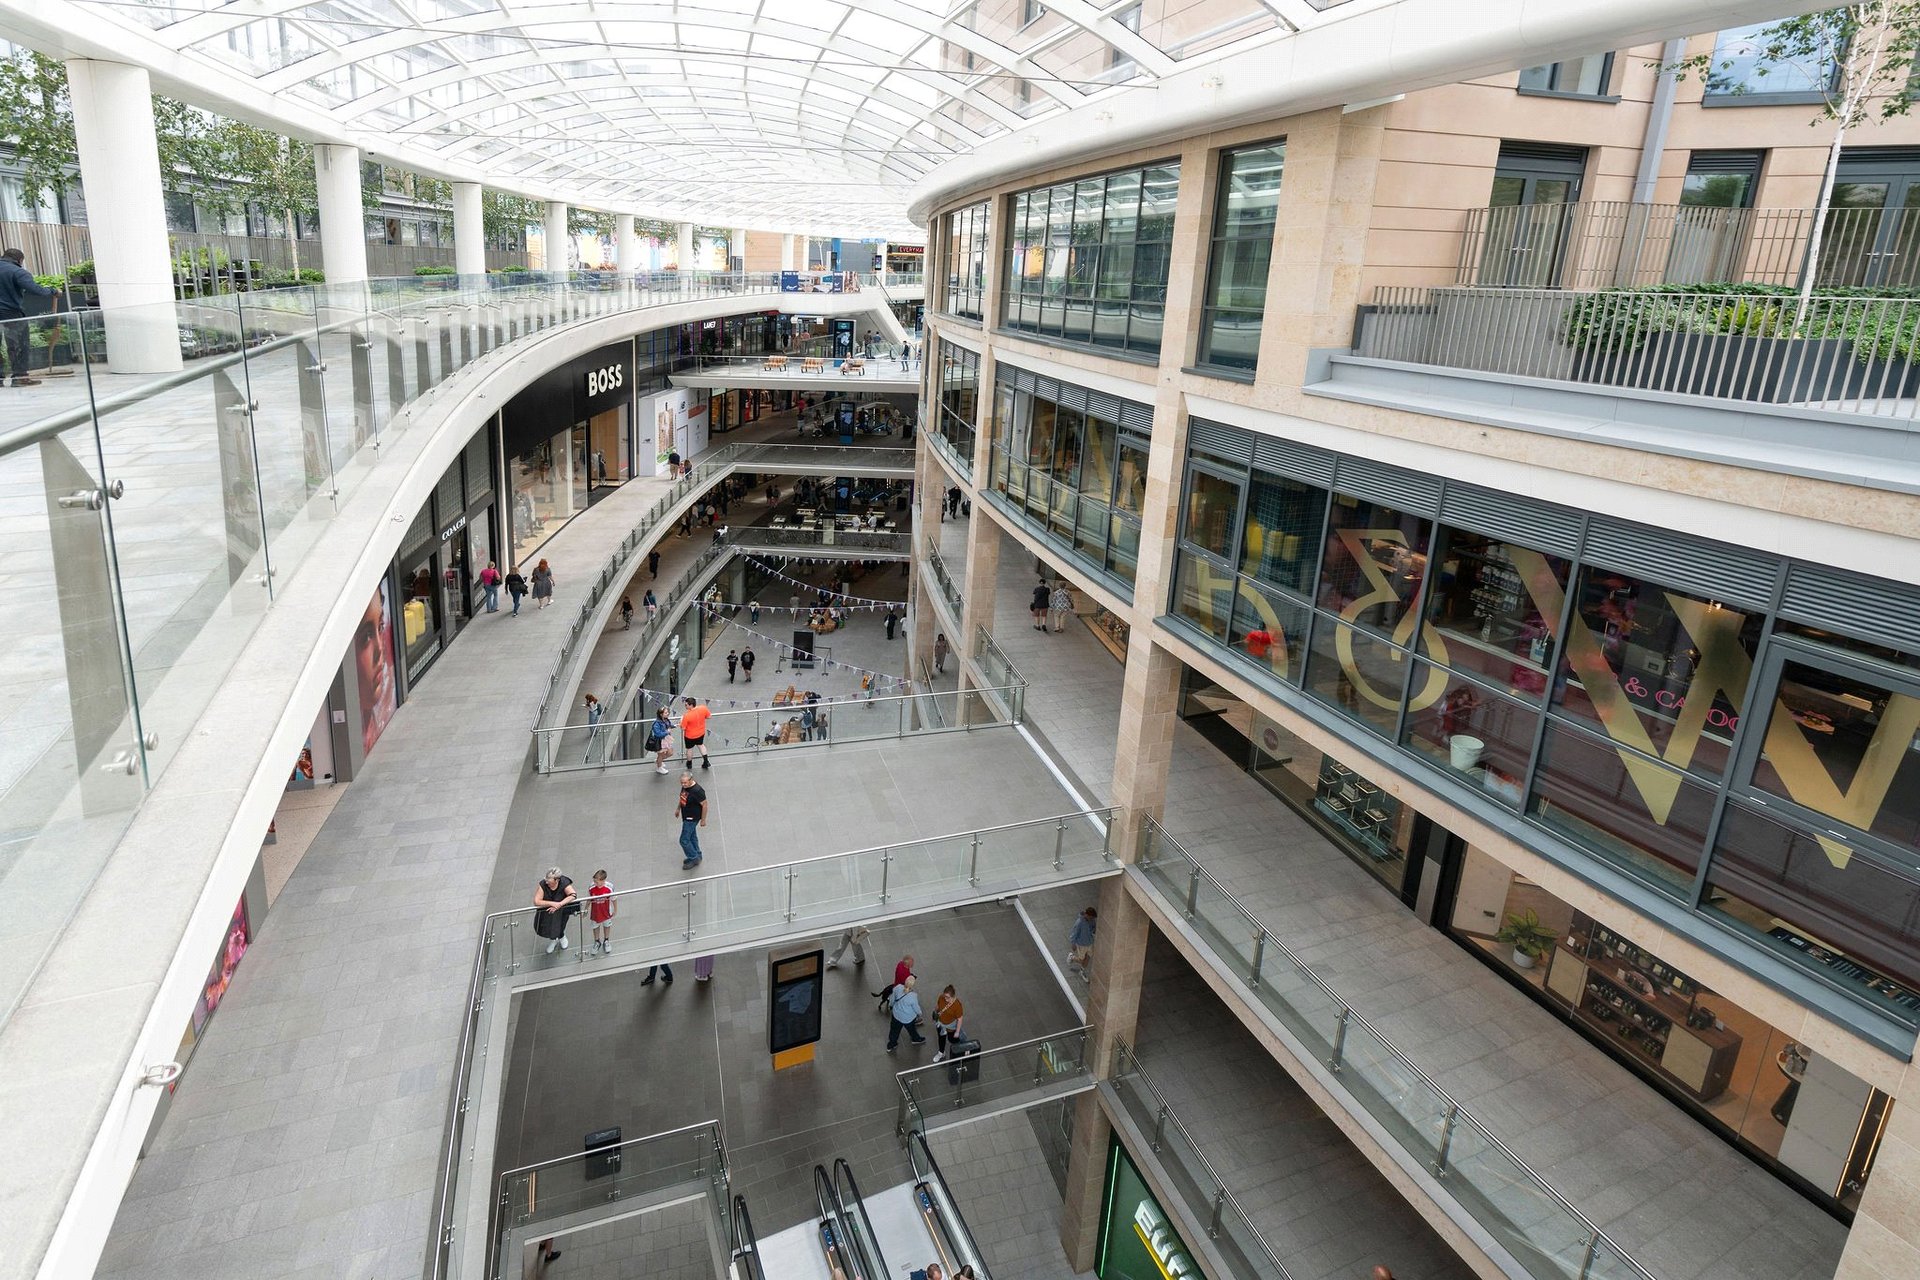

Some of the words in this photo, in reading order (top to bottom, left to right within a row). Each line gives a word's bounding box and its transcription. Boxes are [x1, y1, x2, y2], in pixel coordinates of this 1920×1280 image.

[588, 363, 623, 397] BOSS
[441, 516, 466, 541] COACH
[1625, 676, 1648, 698] &
